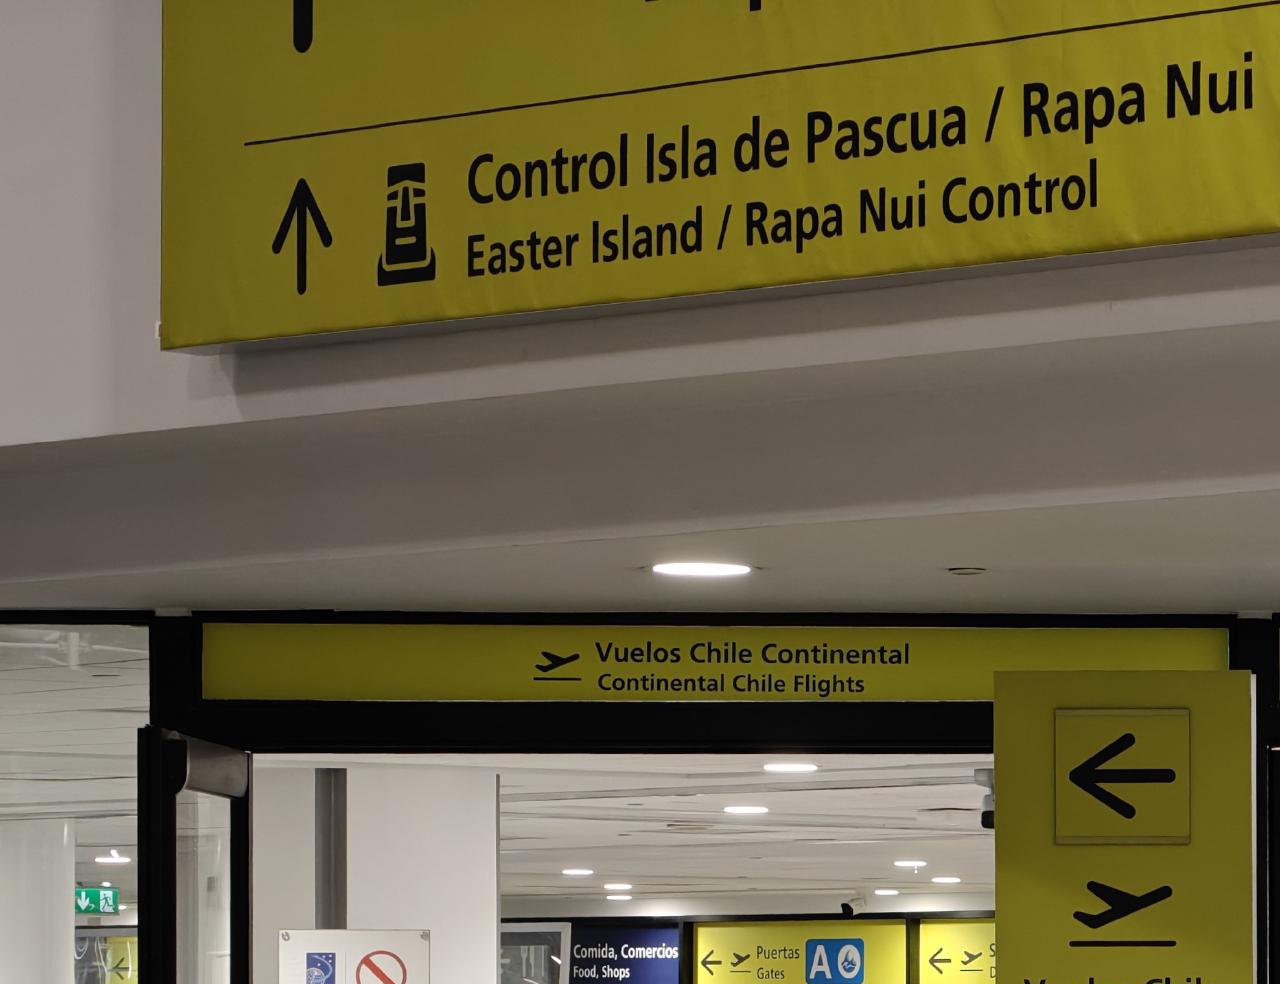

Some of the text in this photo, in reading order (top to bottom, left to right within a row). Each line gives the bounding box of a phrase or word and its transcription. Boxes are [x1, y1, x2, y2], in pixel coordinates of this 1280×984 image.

[467, 51, 1253, 205] Control Isla de Pascua / Rapa Nui
[467, 157, 1098, 278] Easter Island / Rapa Nui Control
[594, 640, 910, 665] Vuelos Chile Continental
[597, 673, 865, 698] Continental Chile Flights
[573, 942, 679, 961] Comida, Comercios
[756, 945, 800, 960] Puertas
[809, 944, 833, 980] A
[573, 964, 631, 981] Food, Shops
[756, 967, 785, 980] Gates
